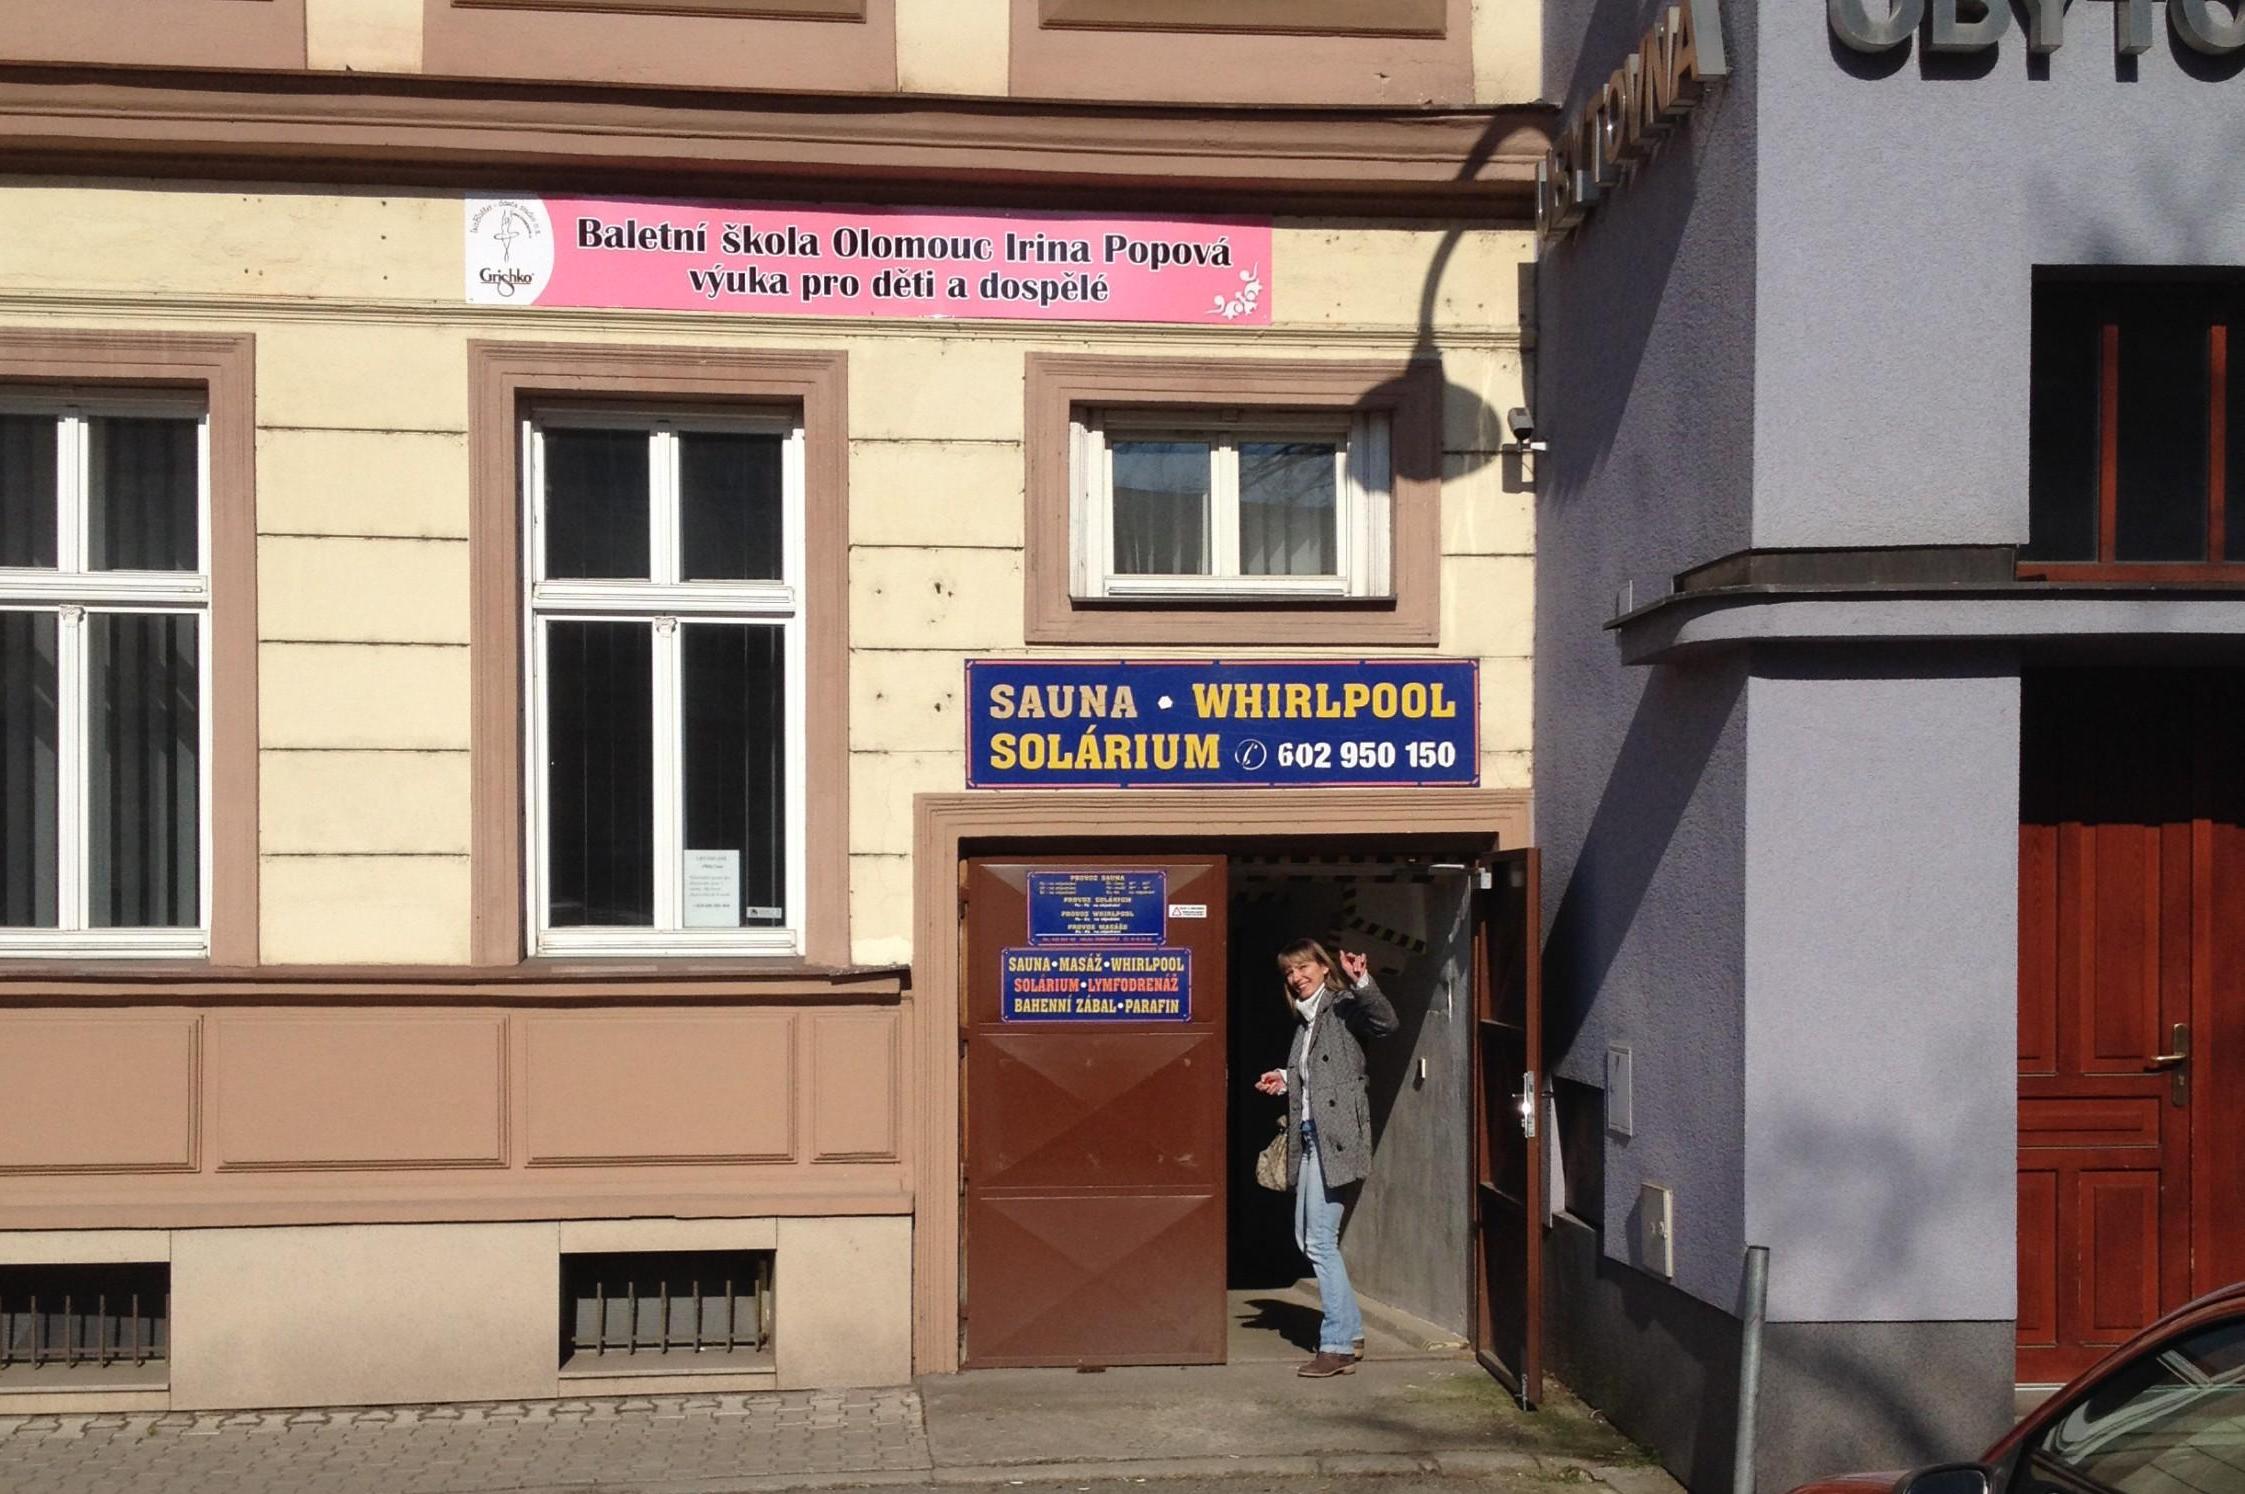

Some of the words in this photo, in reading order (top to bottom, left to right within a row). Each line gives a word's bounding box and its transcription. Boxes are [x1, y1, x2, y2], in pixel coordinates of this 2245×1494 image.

[577, 218, 707, 252] Baletní
[722, 224, 820, 255] škola
[833, 228, 992, 260] Olomouc
[1006, 232, 1090, 262] Irina
[1104, 234, 1231, 269] Popová
[689, 264, 788, 297] výuka
[802, 275, 859, 301] pro
[873, 268, 934, 298] děti
[948, 276, 967, 298] a
[980, 272, 1108, 306] dospělé
[989, 684, 1139, 719] SAUNA
[1192, 682, 1456, 719] WHIRLPOOL
[989, 725, 1221, 770] SOLÁRIUM
[1278, 741, 1332, 769] 602
[1341, 741, 1395, 769] 950
[1405, 741, 1455, 769] 150
[1008, 957, 1050, 972] SAUNA
[1059, 953, 1103, 972] MASÁŽ
[1111, 957, 1185, 972] WHIRLPOOL
[1014, 974, 1080, 992] SOLÁRIUM
[1088, 973, 1179, 992] LYMFODRENÁŽ
[1014, 995, 1072, 1013] BAHENNÍ
[1076, 995, 1117, 1013] ZÁBAL
[1125, 999, 1179, 1014] PARAFIN
